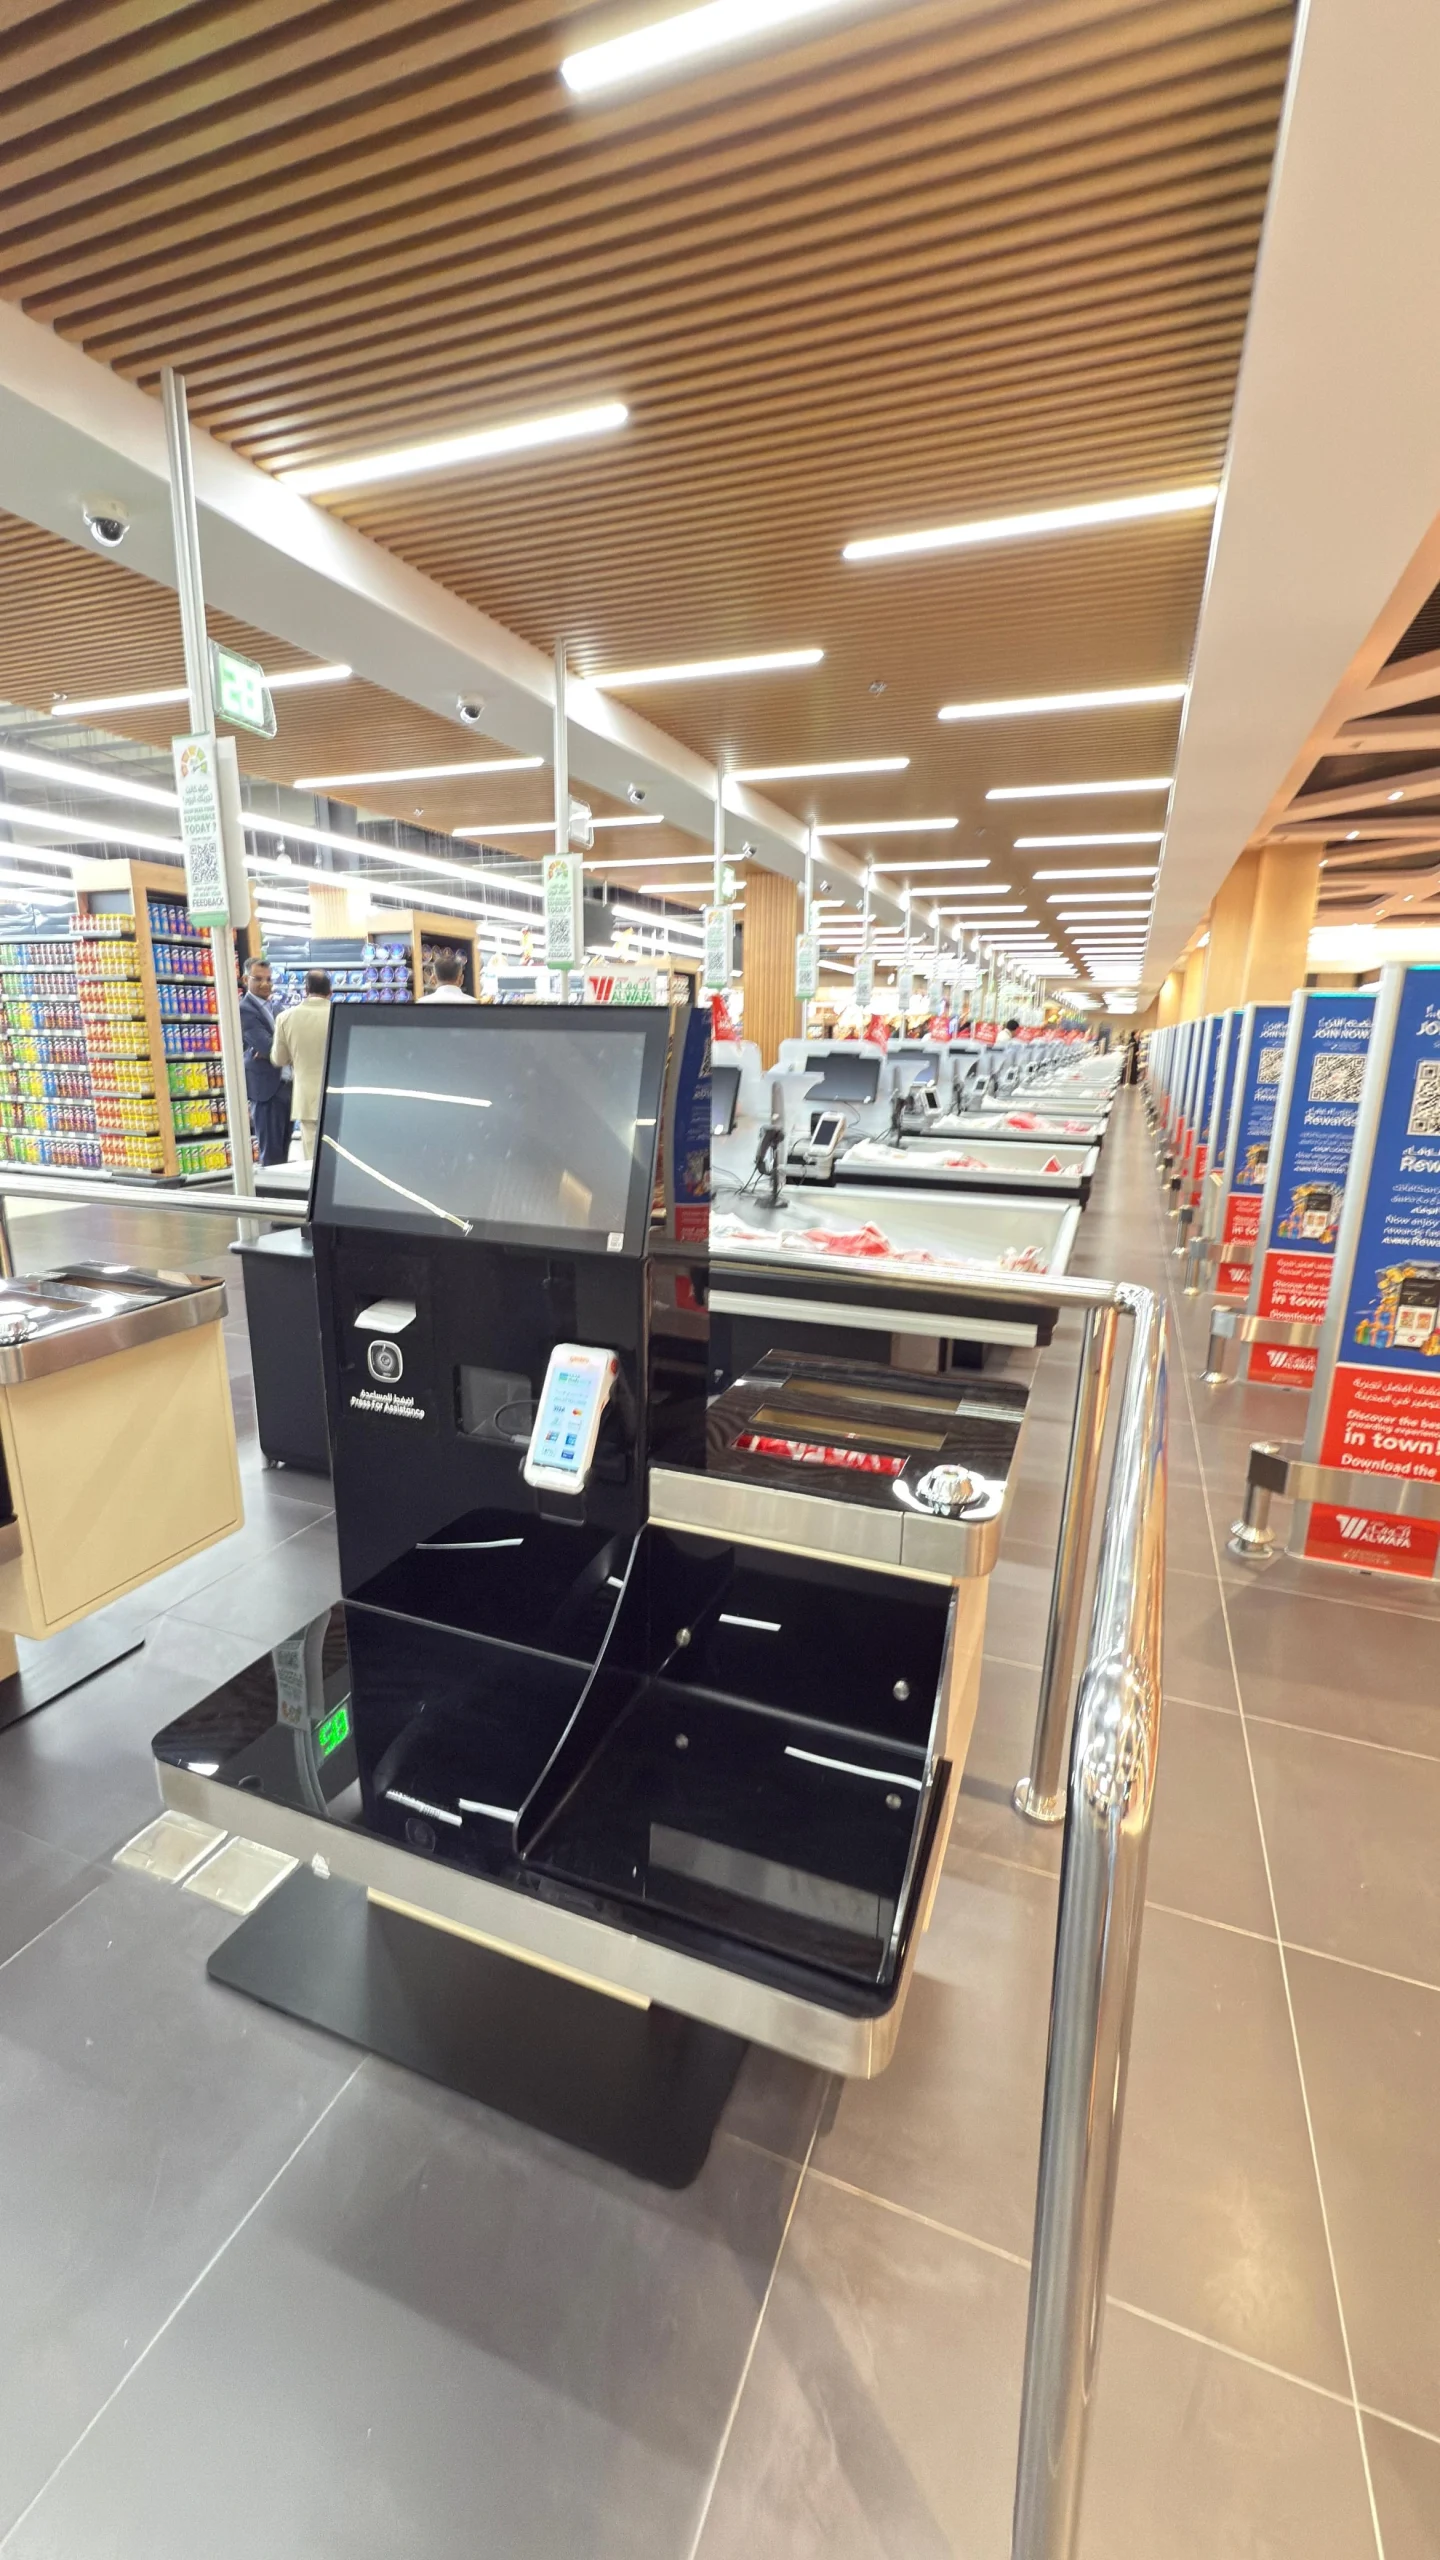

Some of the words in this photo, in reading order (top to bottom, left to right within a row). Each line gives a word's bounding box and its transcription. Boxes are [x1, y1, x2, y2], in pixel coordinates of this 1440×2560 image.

[222, 657, 263, 724] 28
[185, 822, 211, 835] TODAY
[192, 896, 225, 907] FEEDBACK
[1312, 1029, 1340, 1039] JOIN
[1385, 1214, 1411, 1225] Now
[1271, 1292, 1287, 1305] in
[350, 1395, 371, 1411] Press
[371, 1399, 384, 1413] For
[383, 1401, 426, 1420] Assistance
[1346, 1409, 1398, 1424] Discover
[1398, 1415, 1420, 1427] the
[1343, 1426, 1366, 1446] in
[1341, 1453, 1412, 1475] Download
[1412, 1462, 1438, 1478] the
[1360, 1532, 1412, 1548] ALWAFA
